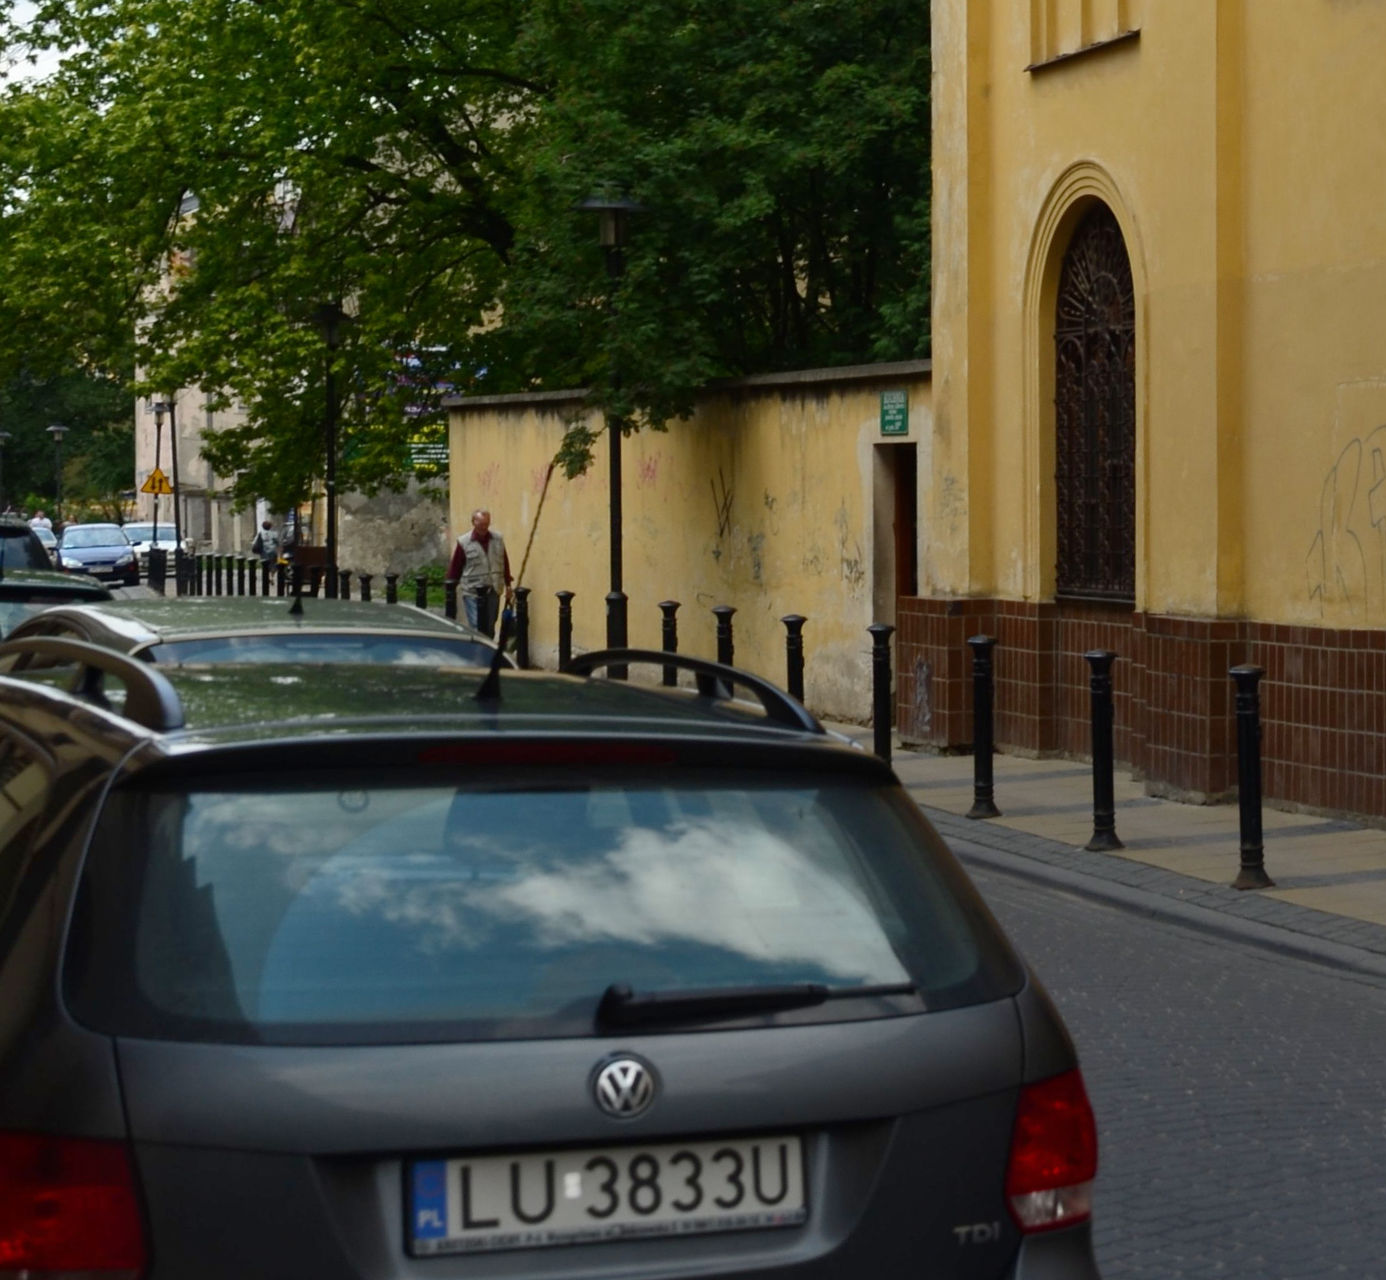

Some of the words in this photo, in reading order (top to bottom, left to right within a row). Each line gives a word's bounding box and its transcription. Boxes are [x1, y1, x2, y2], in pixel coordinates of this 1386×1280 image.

[460, 1159, 556, 1231] LU
[584, 1143, 790, 1220] 3833U
[417, 1209, 444, 1228] PL
[952, 1221, 1001, 1246] TDI
